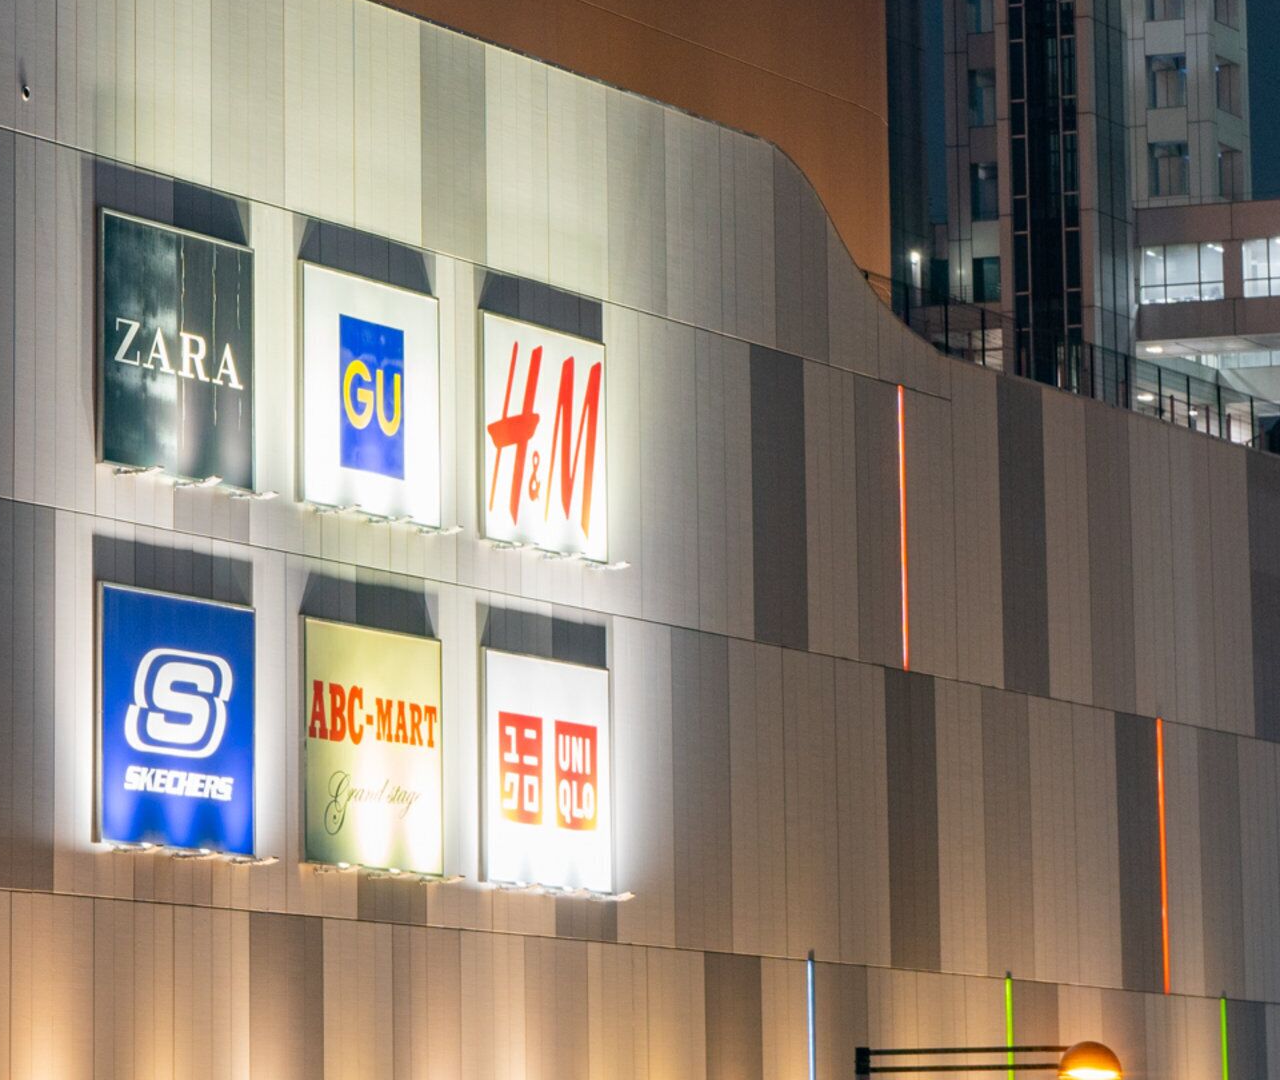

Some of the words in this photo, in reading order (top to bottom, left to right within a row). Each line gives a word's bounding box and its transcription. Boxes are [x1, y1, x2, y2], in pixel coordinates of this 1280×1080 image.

[114, 317, 243, 390] ZARA
[343, 359, 401, 437] GU
[487, 340, 602, 541] H&M
[308, 679, 438, 749] ABC-MART
[124, 765, 234, 802] SKECHERS
[558, 734, 592, 776] UNI
[558, 779, 595, 824] QLO
